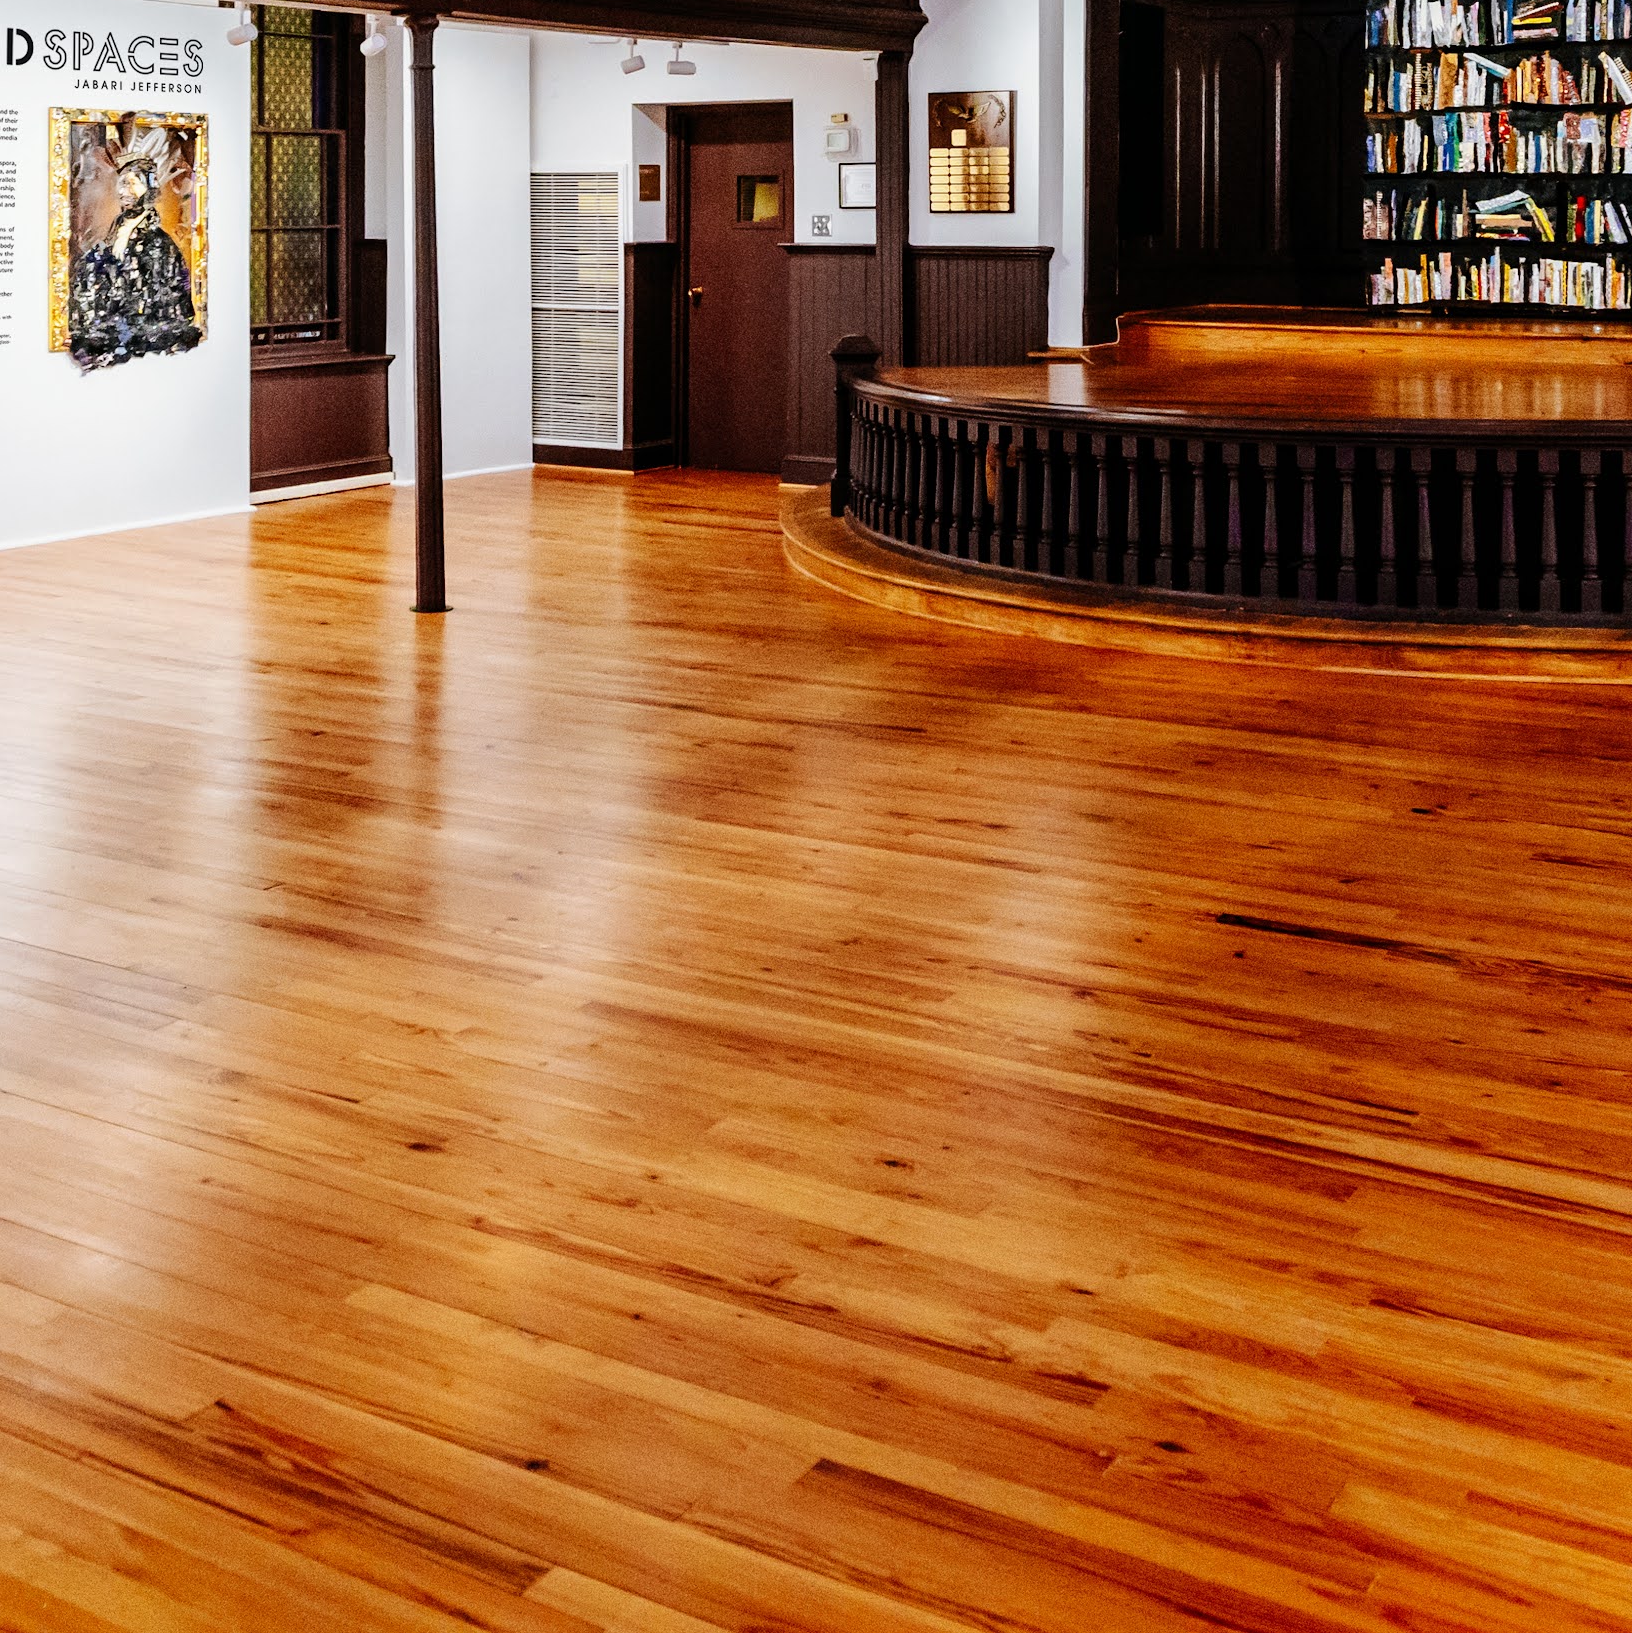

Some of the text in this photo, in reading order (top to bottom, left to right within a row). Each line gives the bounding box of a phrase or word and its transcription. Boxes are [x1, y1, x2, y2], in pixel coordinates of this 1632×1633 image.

[43, 29, 204, 77] SPACES
[74, 79, 202, 94] JABARI JEFFERSON
